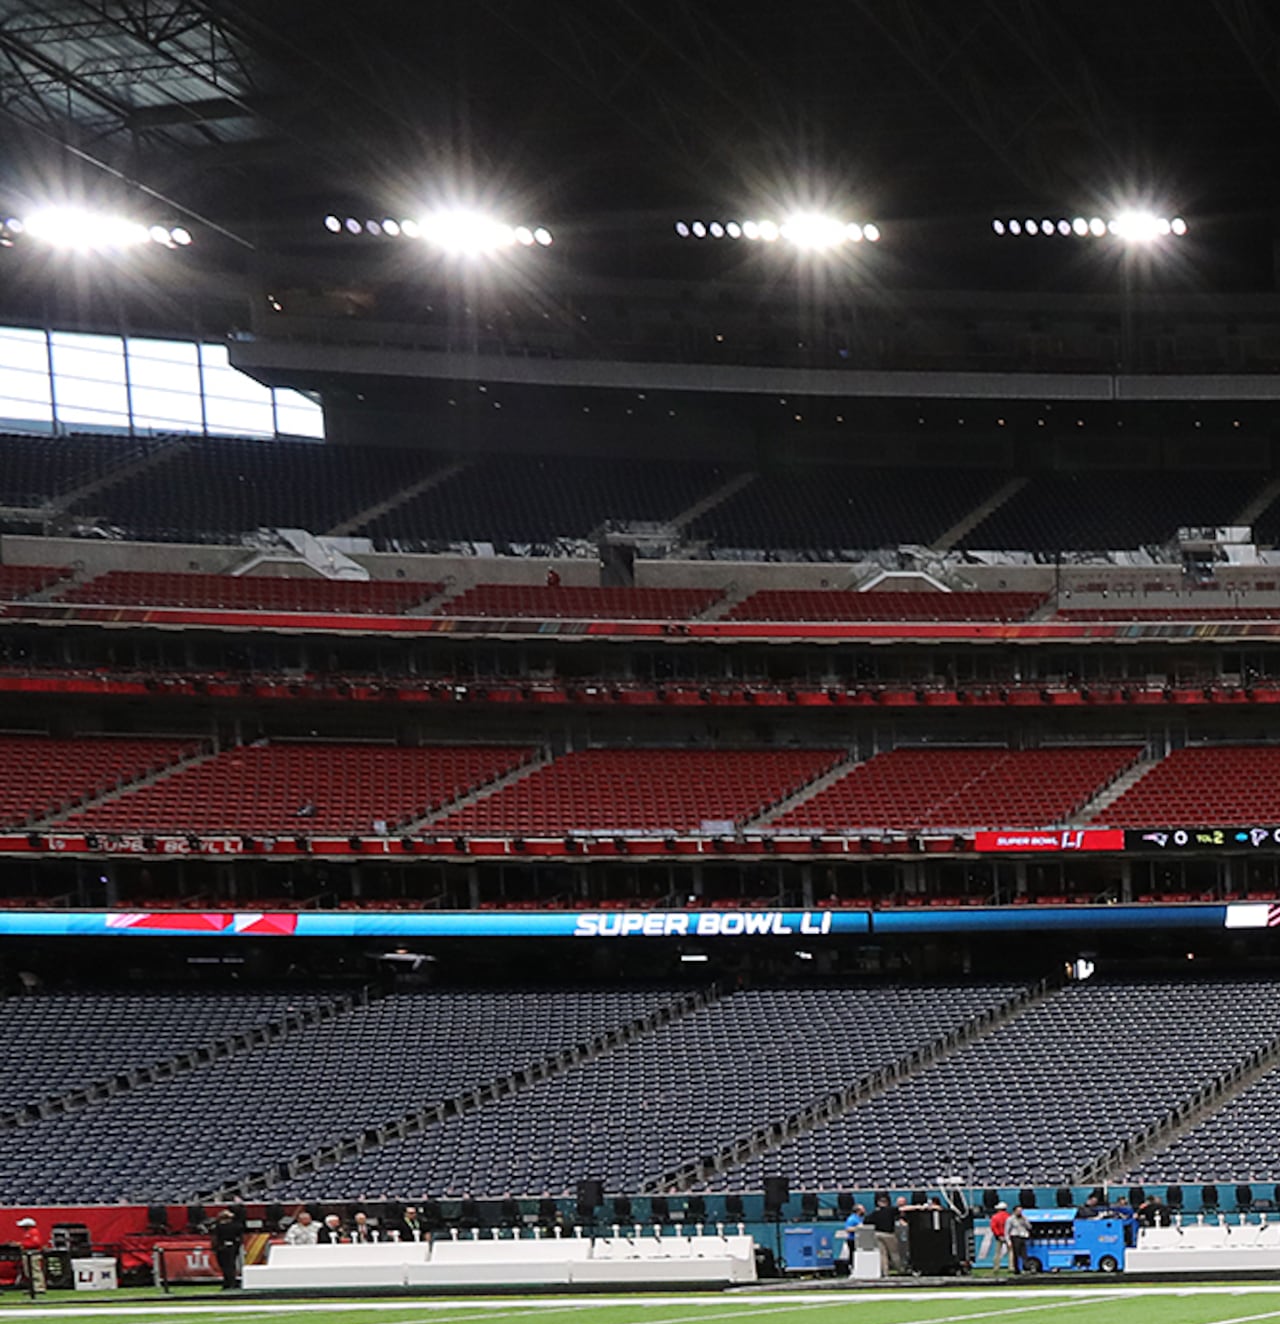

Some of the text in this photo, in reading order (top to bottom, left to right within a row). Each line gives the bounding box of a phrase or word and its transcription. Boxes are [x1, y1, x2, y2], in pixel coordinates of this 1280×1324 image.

[997, 836, 1030, 846] SUPER
[1031, 835, 1058, 846] BOWL
[1173, 831, 1188, 845] 0
[1214, 831, 1225, 845] 2
[574, 911, 832, 937] SUPER BOWL LI
